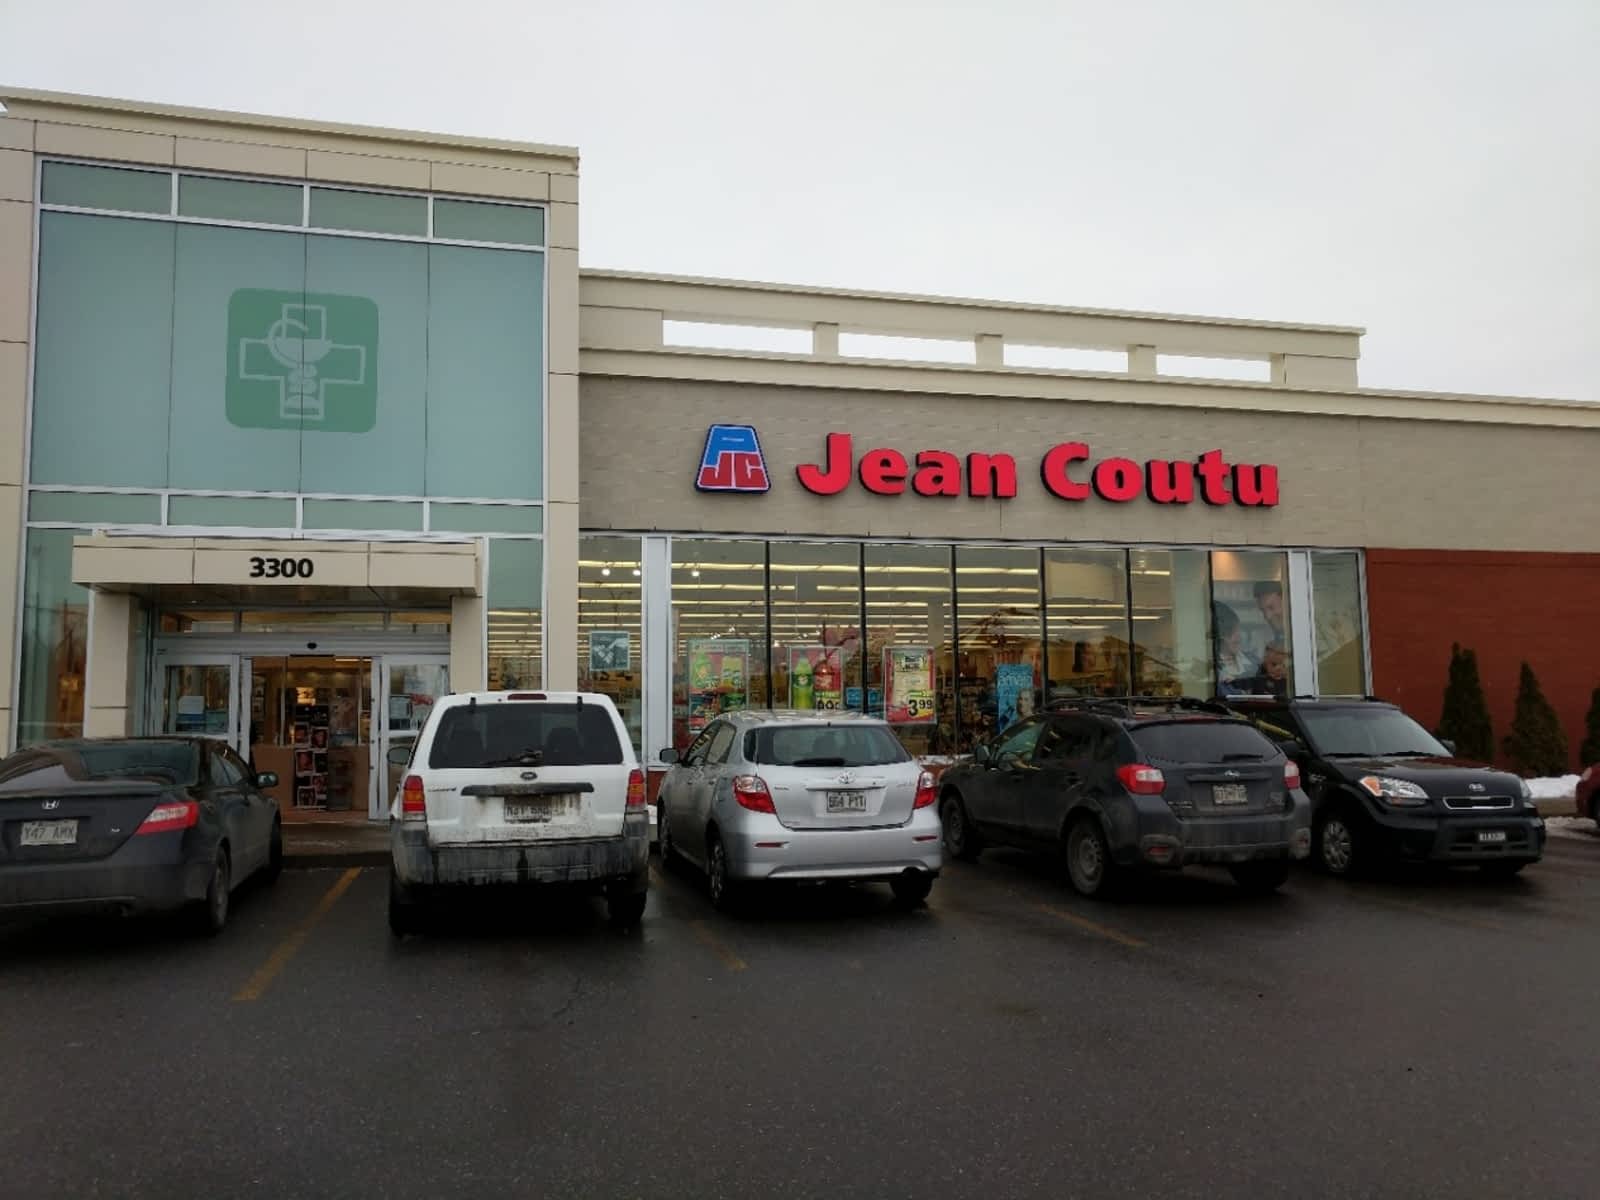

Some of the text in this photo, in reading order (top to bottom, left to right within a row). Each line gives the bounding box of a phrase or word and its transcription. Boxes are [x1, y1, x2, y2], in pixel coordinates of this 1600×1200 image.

[796, 432, 1280, 507] Jean Coutu
[249, 556, 314, 578] 3300
